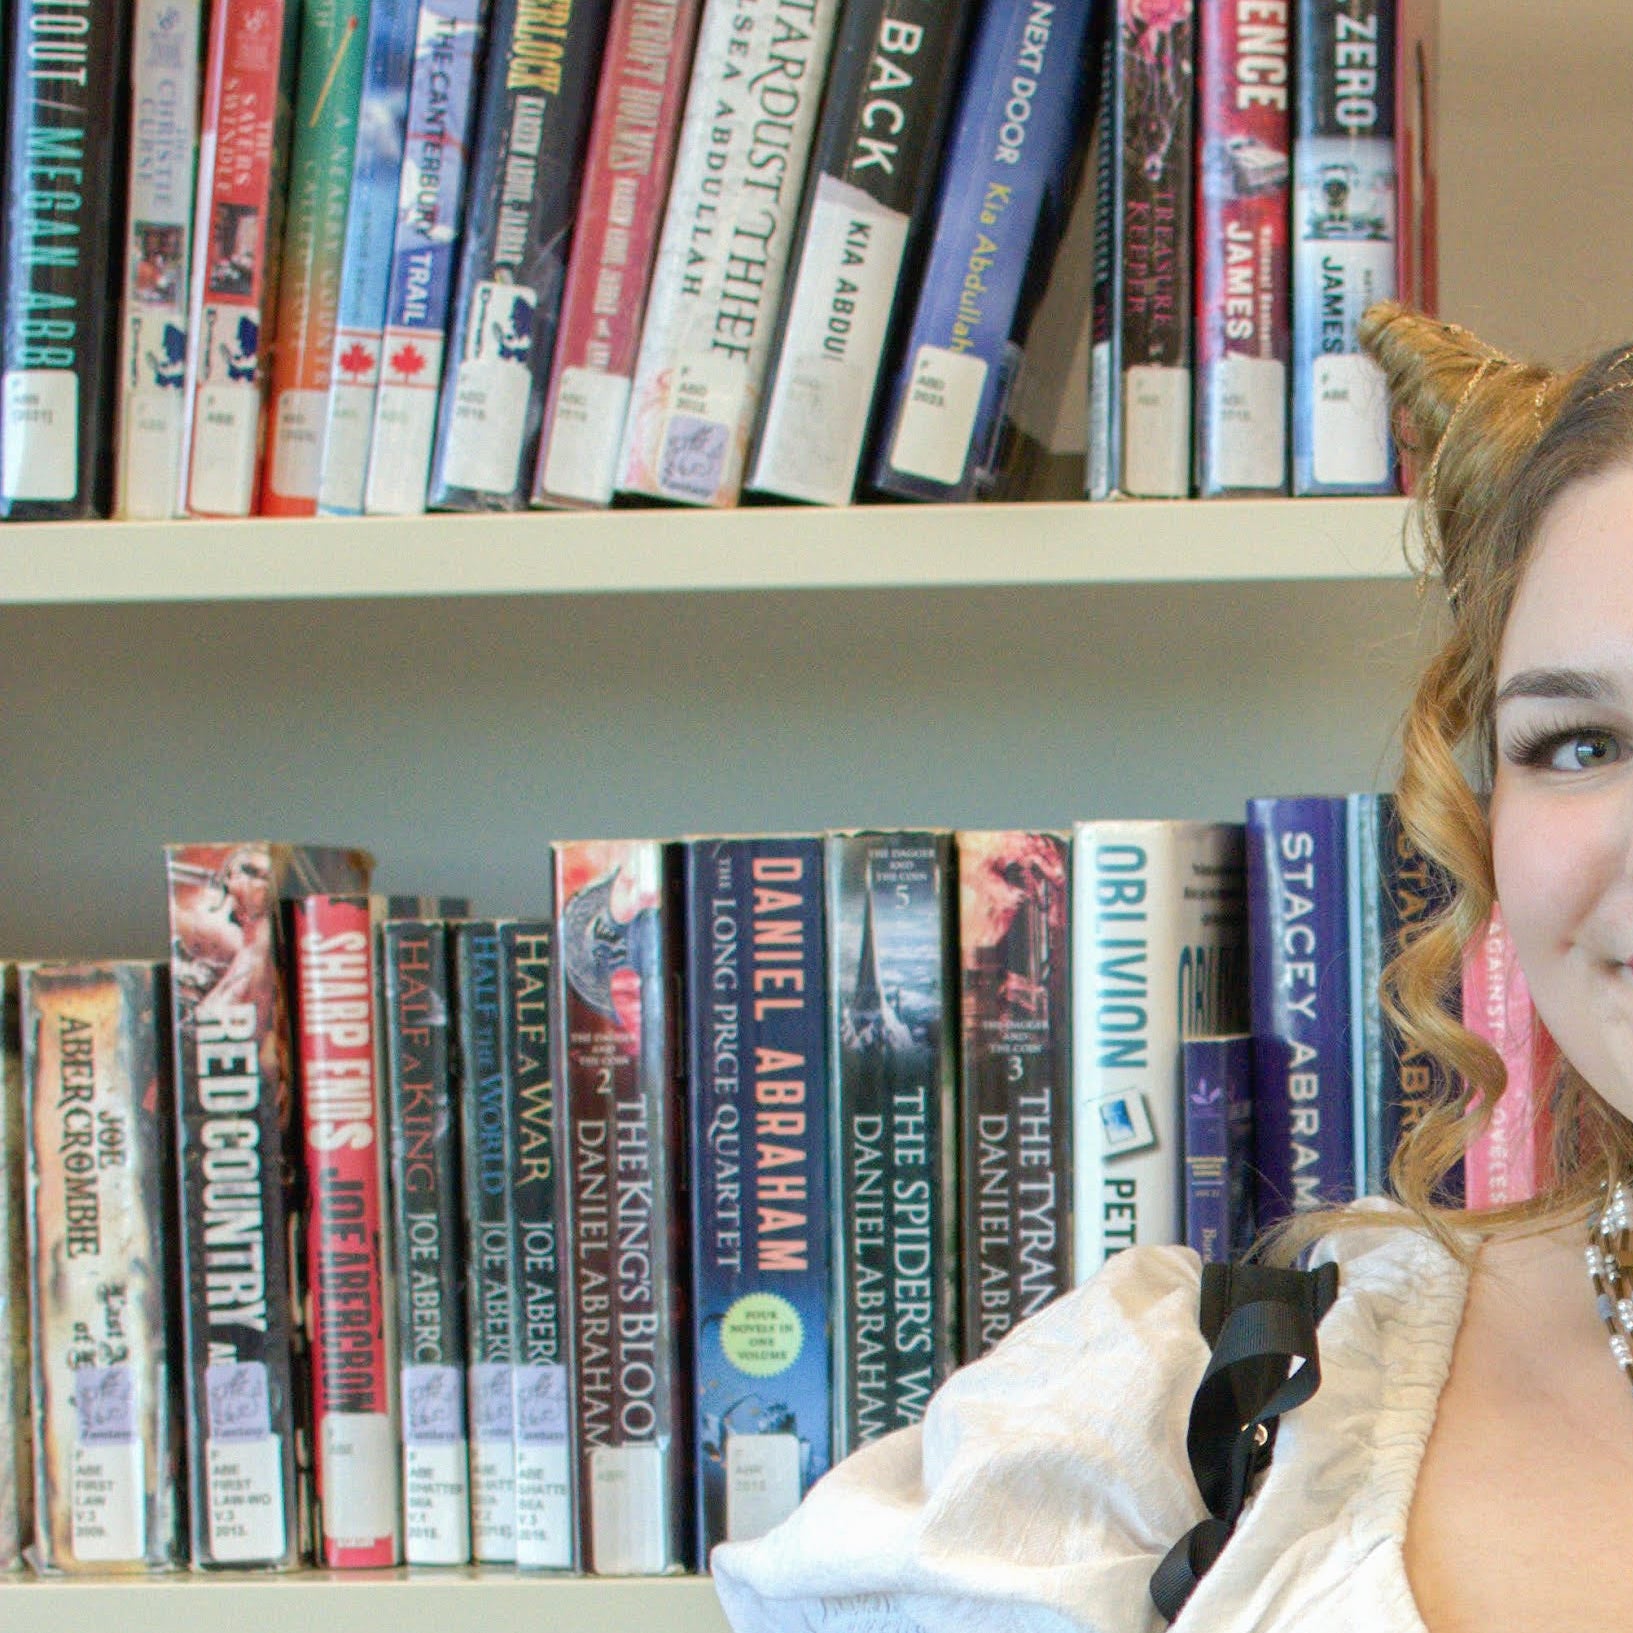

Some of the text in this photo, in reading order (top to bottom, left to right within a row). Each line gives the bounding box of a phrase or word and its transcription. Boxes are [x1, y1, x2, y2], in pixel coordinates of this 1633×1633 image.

[416, 17, 457, 240] THE CANTERBURY
[851, 18, 923, 174] BACK
[995, 2, 1056, 164] NEXT DOOR
[1333, 15, 1379, 127] ZERO
[22, 128, 86, 266] MEGAN
[681, 100, 735, 296] ABDULLAH
[841, 221, 872, 266] KIA
[979, 182, 1010, 224] Kia
[401, 250, 433, 325] TRAIL
[708, 212, 776, 364] THIEF
[1225, 221, 1255, 340] JAMES
[709, 899, 741, 991] LONG
[895, 885, 910, 910] 5
[1096, 843, 1149, 1069] OBLIVION
[1281, 832, 1320, 1020] STACEY
[300, 930, 373, 1149] SHARP ENDS
[401, 938, 437, 1048] HALF
[512, 934, 555, 1188] HALF A WAR
[711, 1003, 741, 1095] PRICE
[752, 858, 809, 1272] DANIEL ABRAHAM
[1007, 1056, 1024, 1081] 3
[1019, 1087, 1051, 1168] THE
[55, 1016, 99, 1258] ABERCROMBIE
[96, 1111, 126, 1174] JOE
[197, 1015, 267, 1332] RED COUNTRY
[317, 1168, 364, 1242] JOE
[402, 1081, 441, 1194] KING
[576, 1119, 610, 1263] DANIEL
[707, 1104, 742, 1274] QUARTET
[851, 1113, 886, 1257] DANIEL
[977, 1113, 1010, 1257] DANIEL
[408, 1211, 442, 1262] JOE
[480, 1219, 509, 1271] JOE
[520, 1220, 557, 1274] JOE
[893, 1086, 934, 1352] THE SPIDER'S
